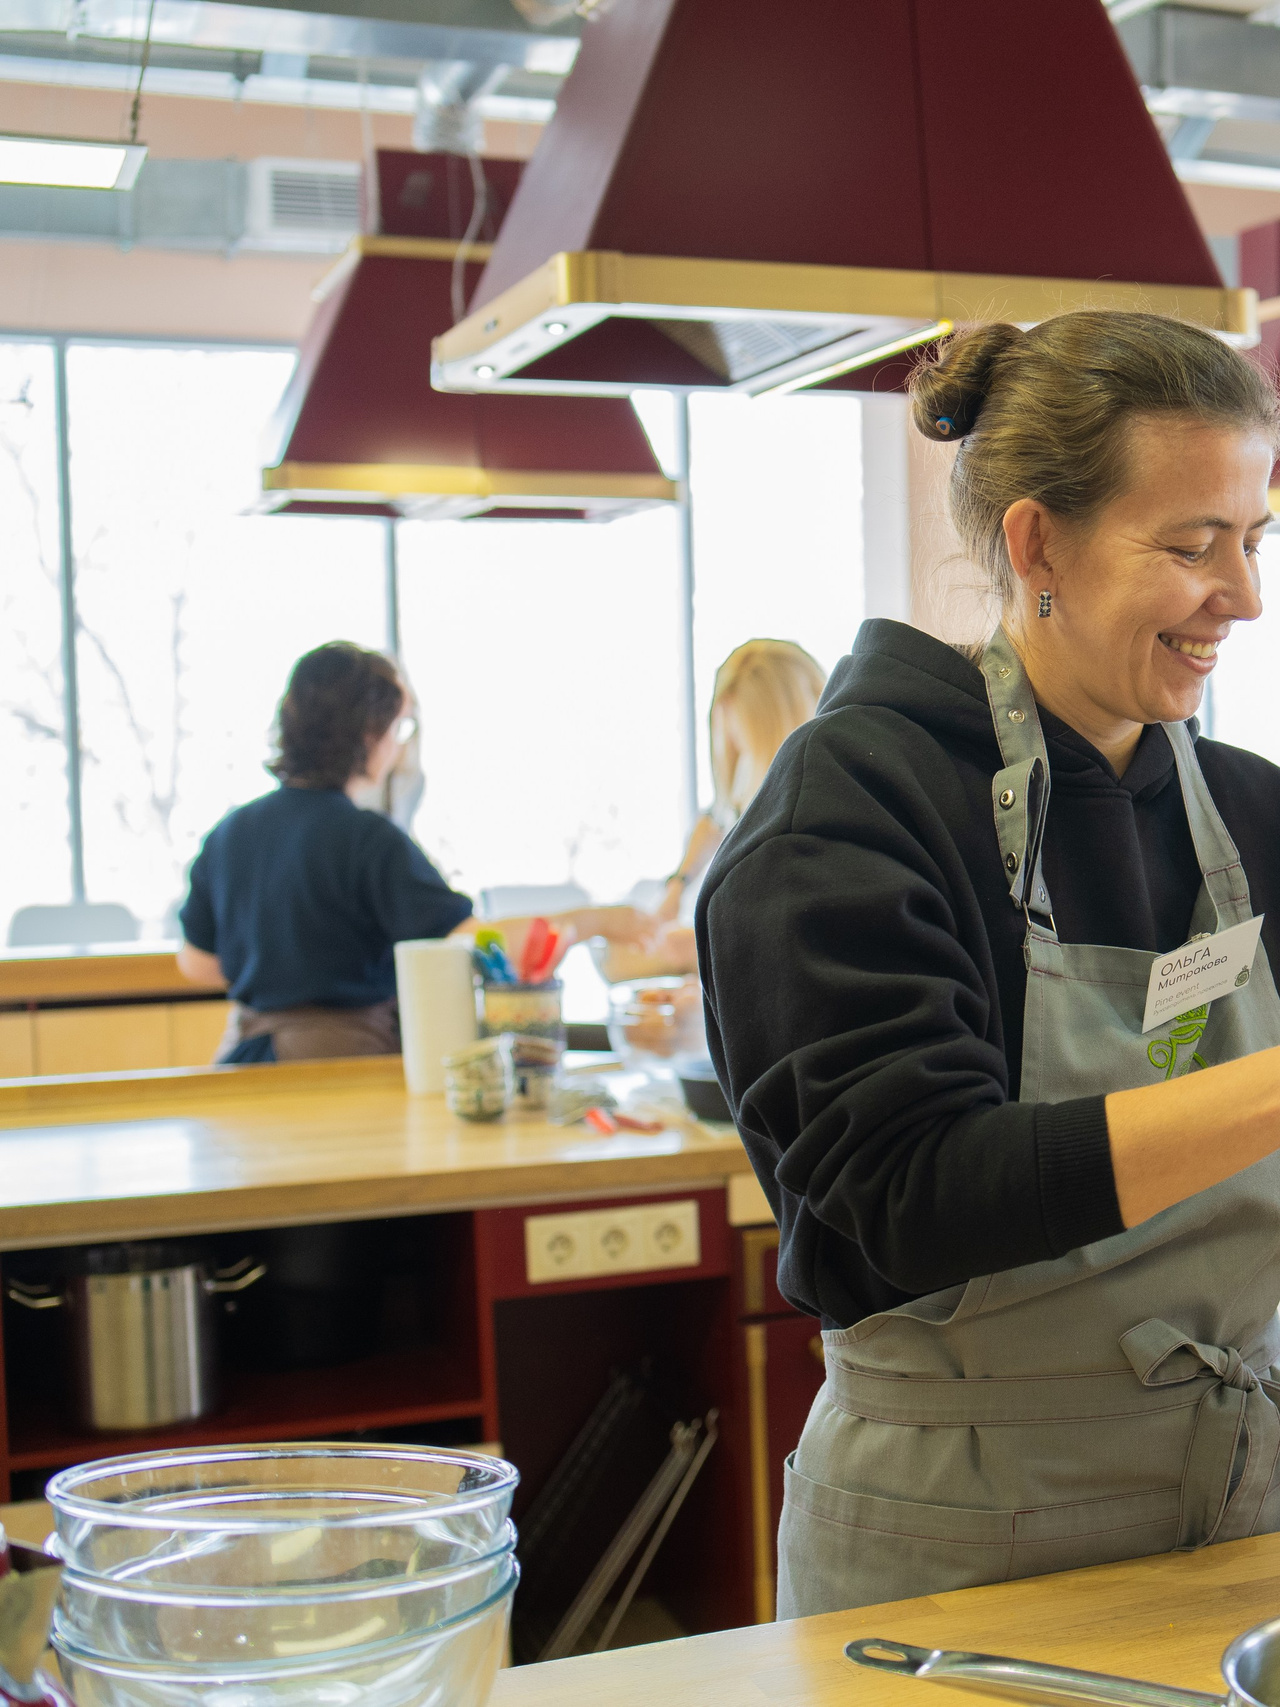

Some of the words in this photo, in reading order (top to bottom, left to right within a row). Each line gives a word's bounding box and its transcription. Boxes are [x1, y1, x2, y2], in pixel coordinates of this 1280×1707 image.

[1158, 956, 1228, 991] Митракова
[1161, 947, 1211, 976] ОЛЬГА
[1154, 995, 1174, 1009] Pine
[1176, 983, 1200, 999] event
